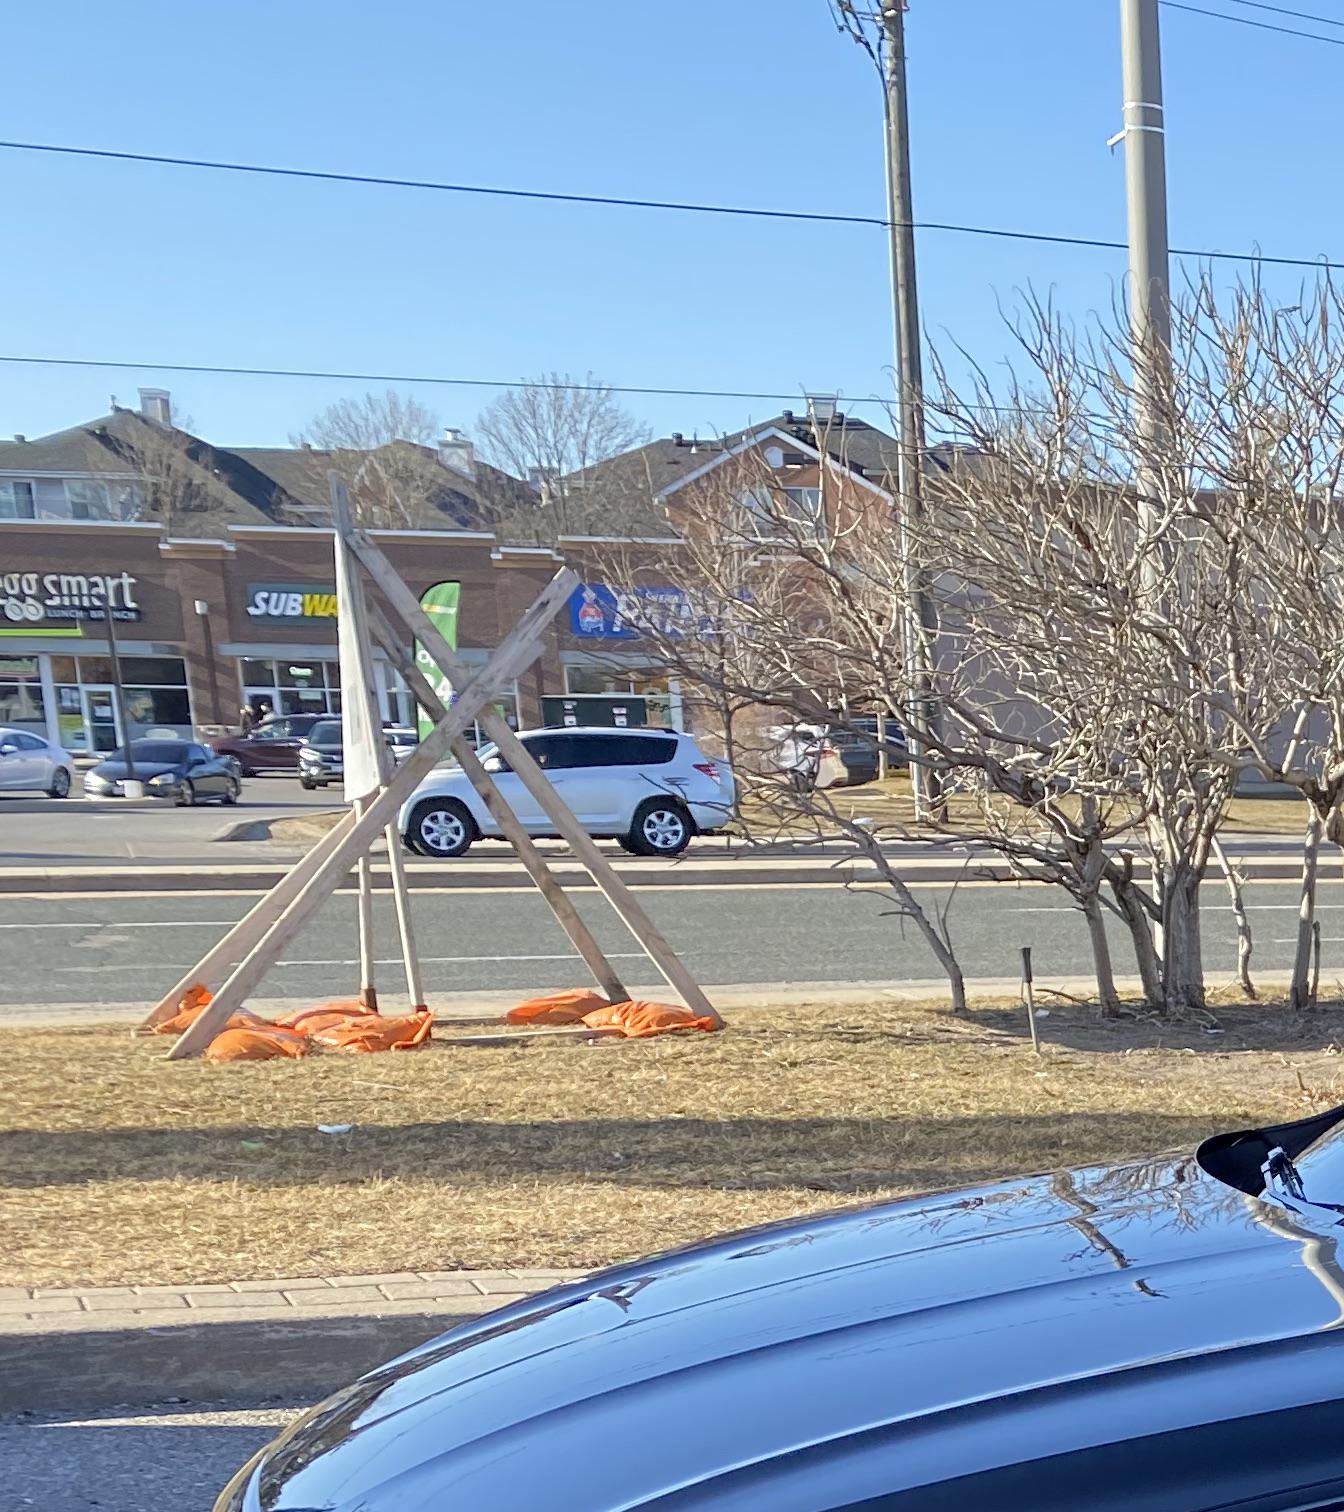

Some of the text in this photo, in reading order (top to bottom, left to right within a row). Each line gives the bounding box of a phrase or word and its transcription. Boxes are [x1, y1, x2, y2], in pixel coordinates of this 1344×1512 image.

[43, 571, 138, 609] smart
[90, 610, 137, 620] BRNCH
[246, 591, 337, 617] SUBWA
